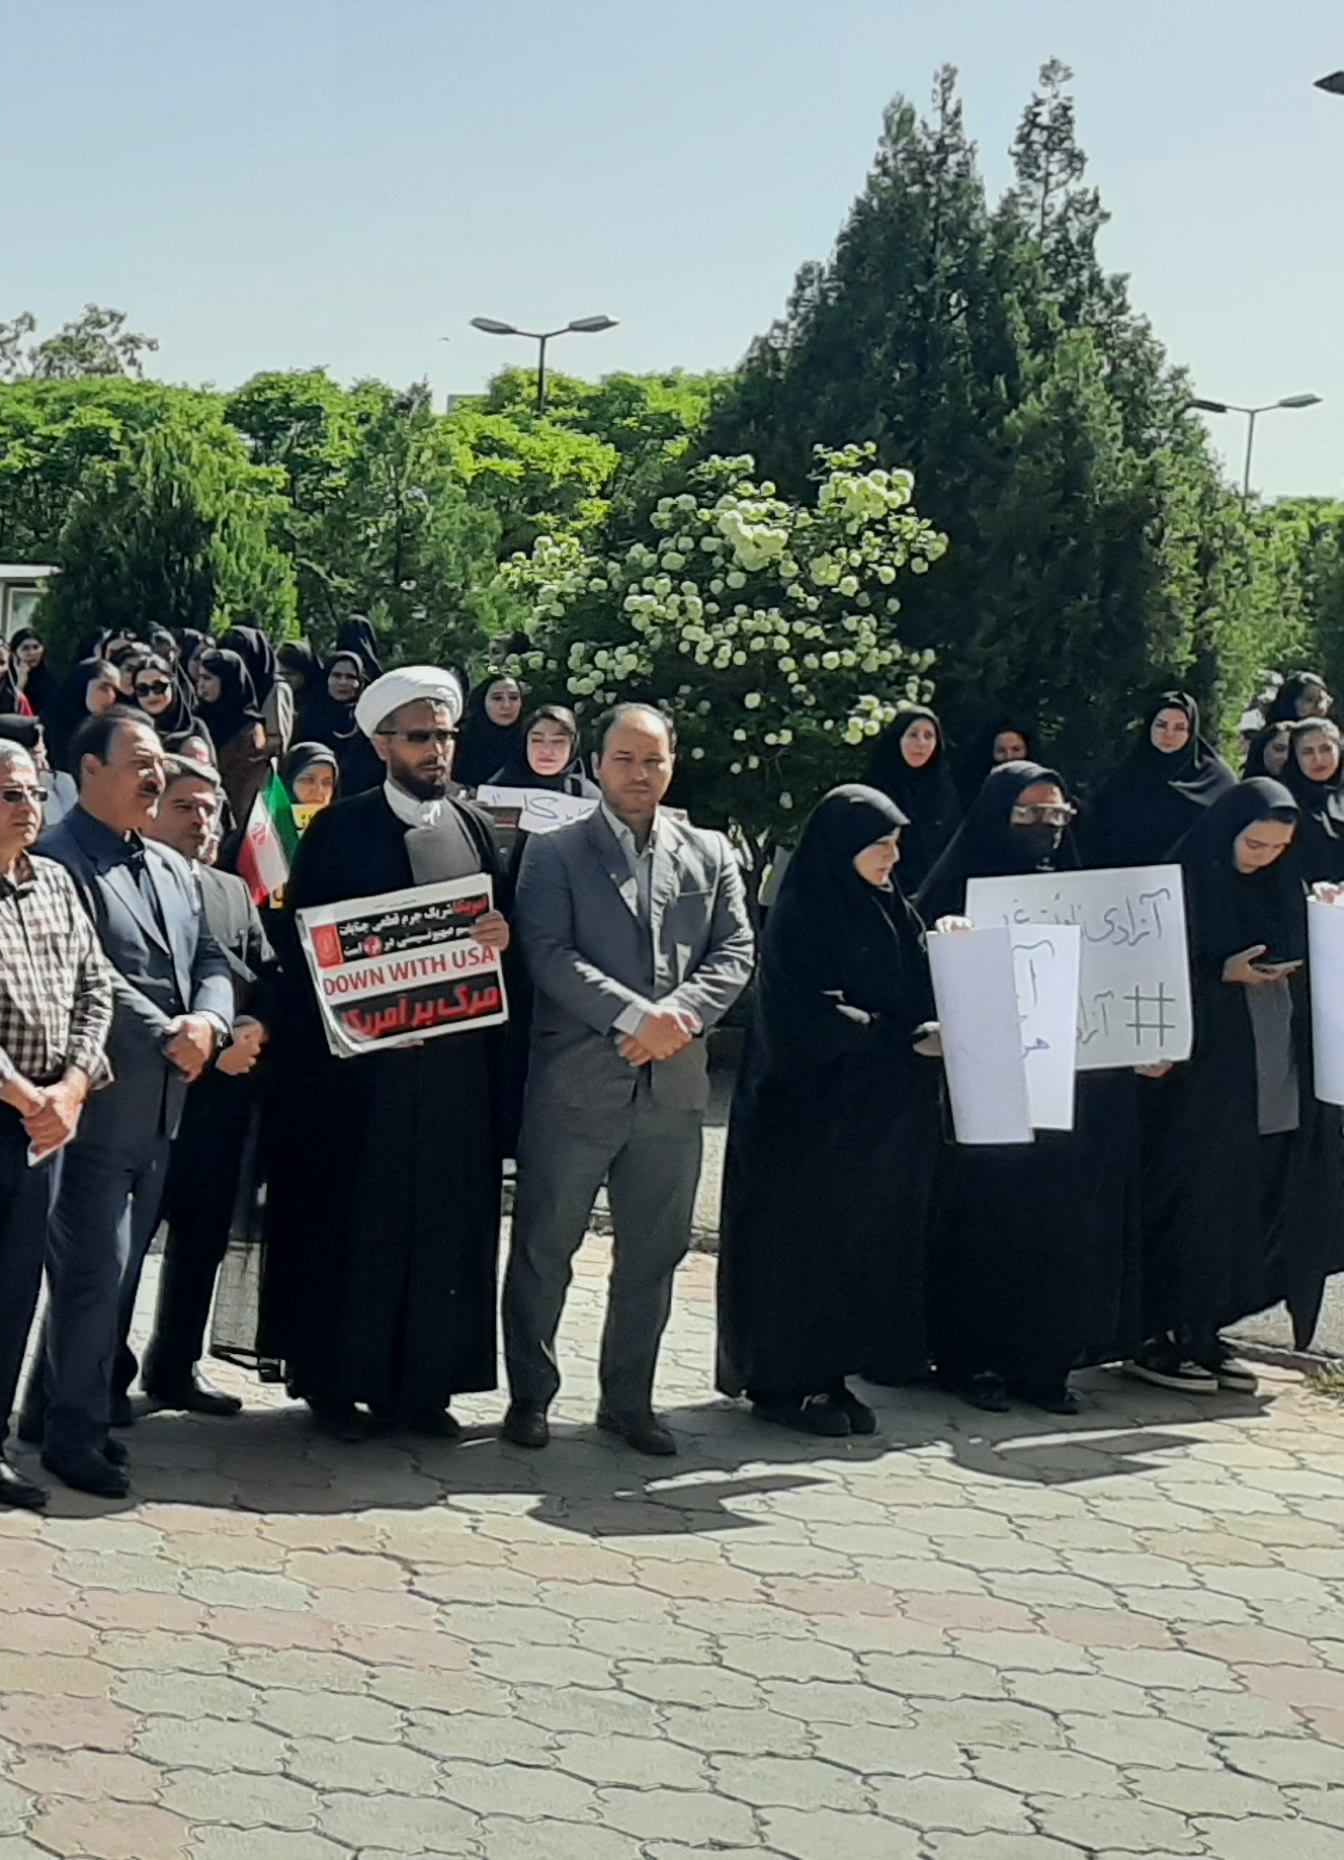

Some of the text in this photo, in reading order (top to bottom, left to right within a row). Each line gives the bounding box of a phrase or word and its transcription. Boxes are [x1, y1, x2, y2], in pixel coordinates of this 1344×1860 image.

[401, 912, 422, 927] جرم
[1084, 888, 1171, 946] آزادی
[323, 946, 495, 996] DOWN WITH USA
[412, 999, 434, 1028] بر
[437, 984, 502, 1017] مرگ
